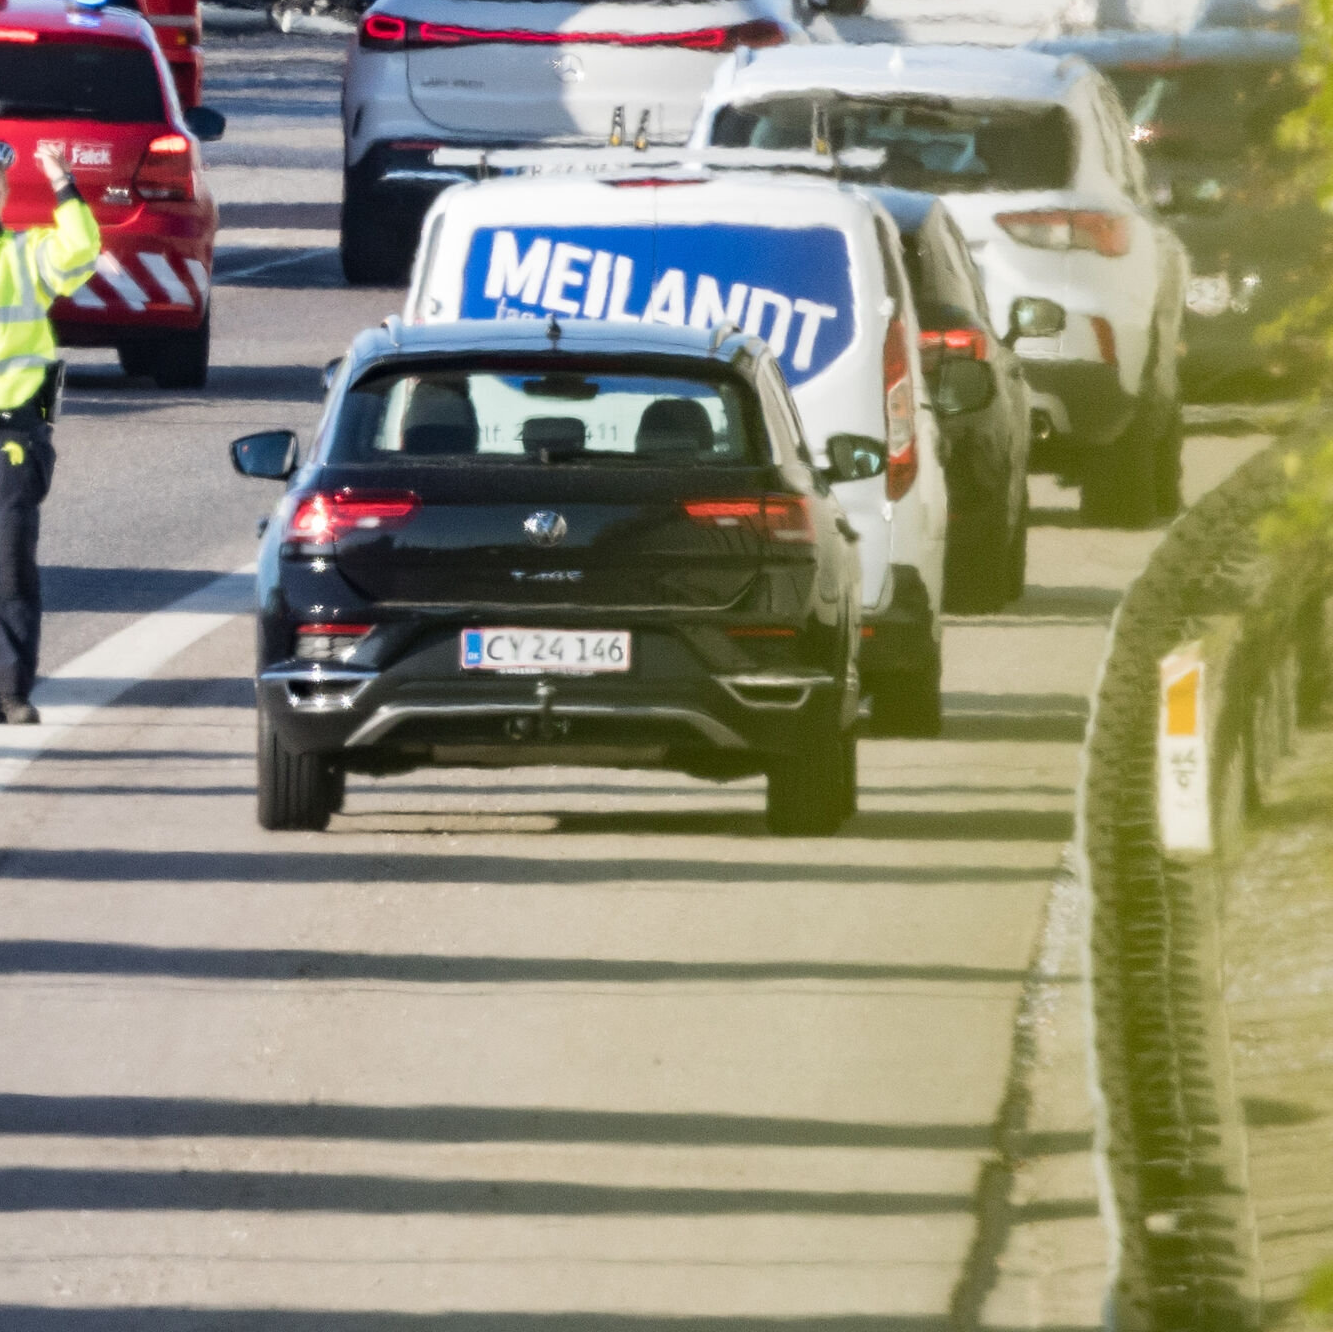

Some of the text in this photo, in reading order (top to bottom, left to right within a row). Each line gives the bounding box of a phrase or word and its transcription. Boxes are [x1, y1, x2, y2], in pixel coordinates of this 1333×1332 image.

[72, 148, 111, 165] Falck
[484, 230, 837, 371] MEILANDT
[486, 634, 625, 662] CY 24 146
